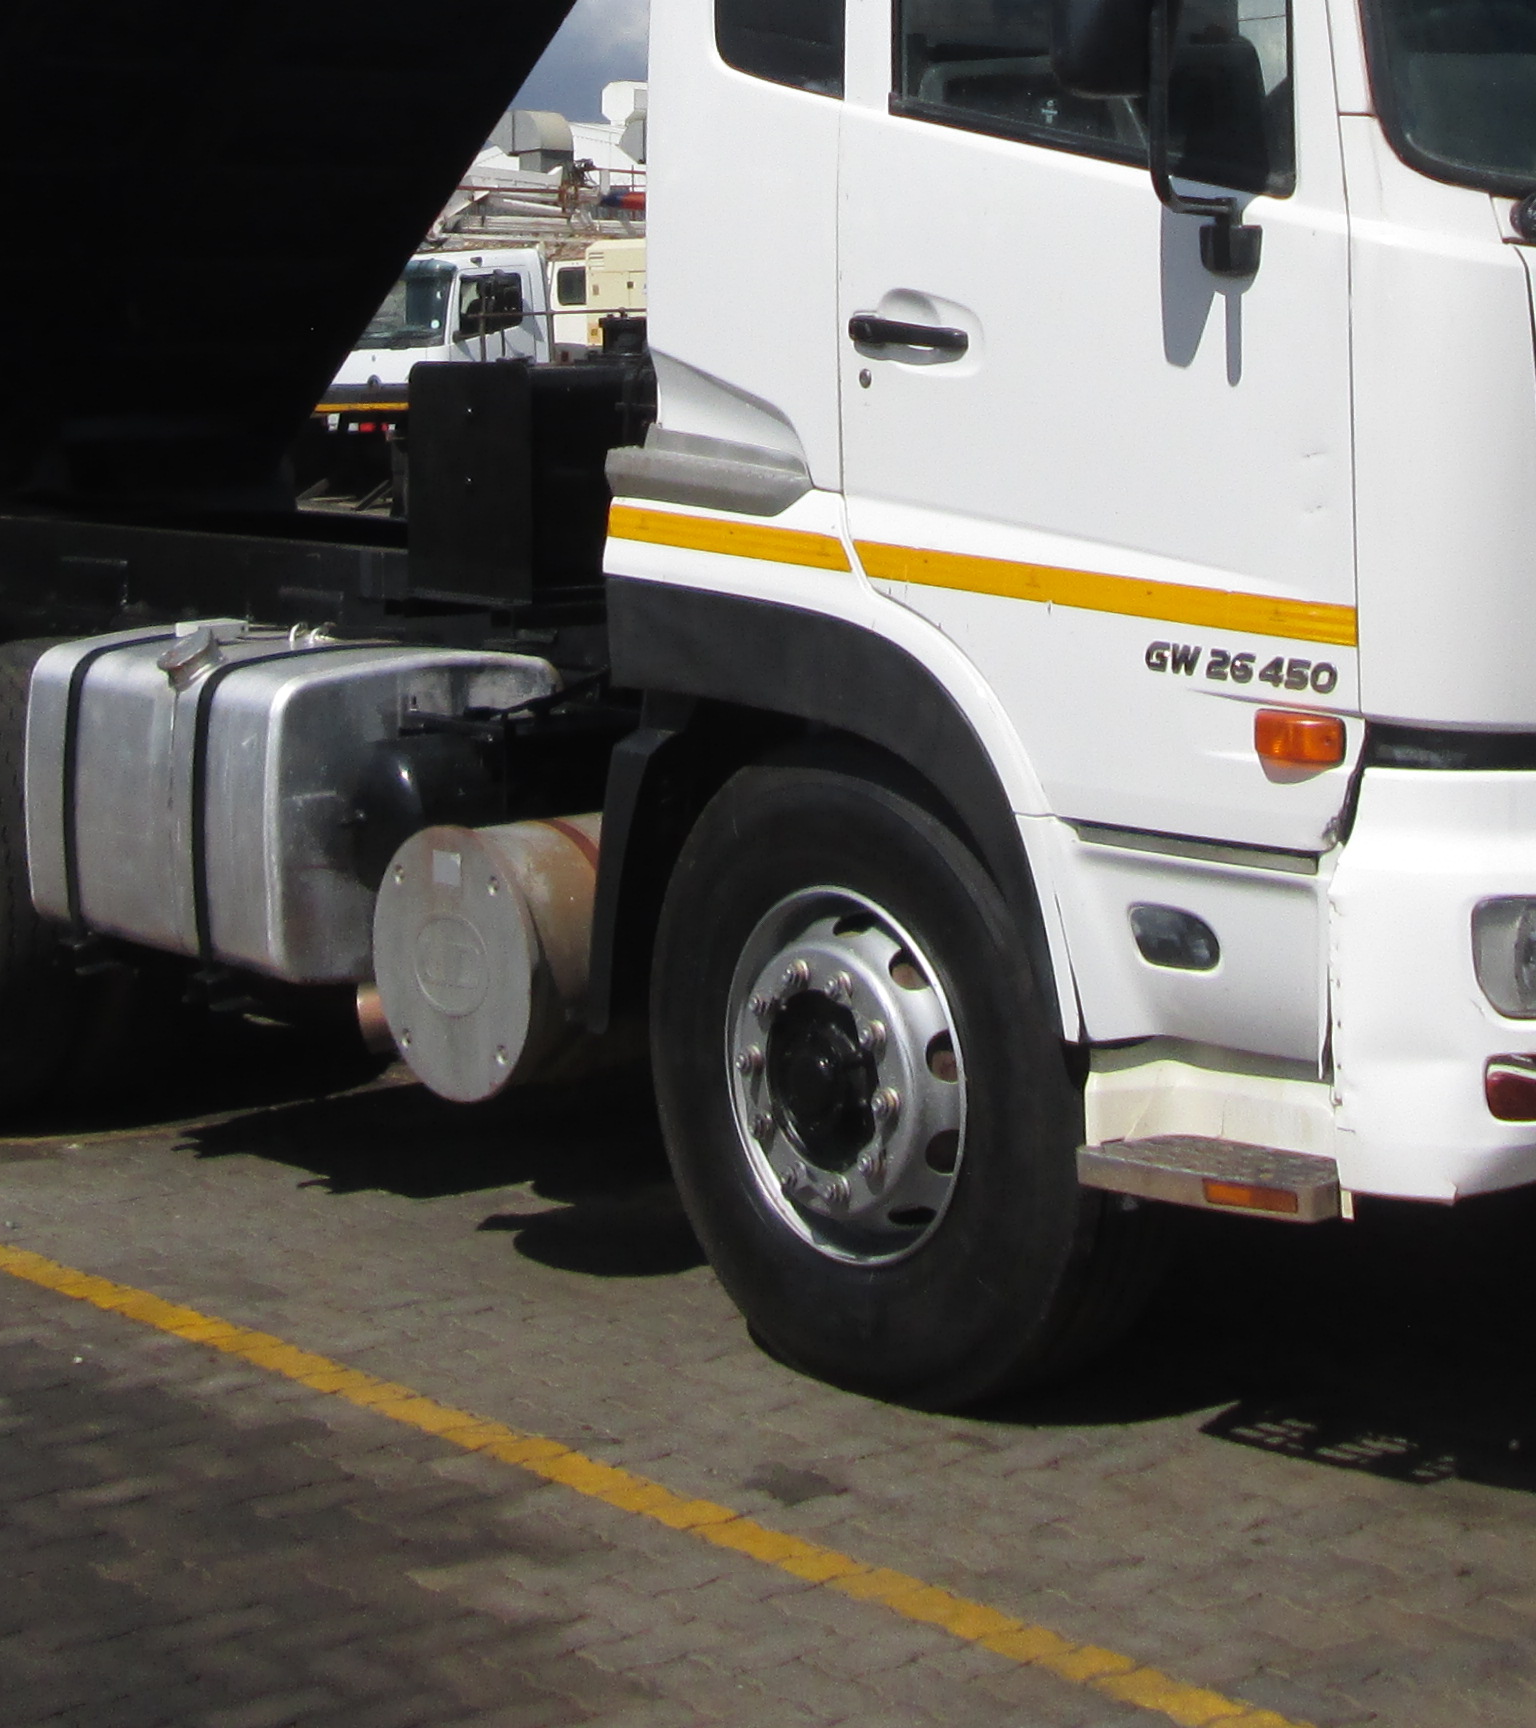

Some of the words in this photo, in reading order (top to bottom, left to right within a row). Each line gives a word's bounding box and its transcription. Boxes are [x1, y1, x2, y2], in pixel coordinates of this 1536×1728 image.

[1144, 640, 1202, 676] GW
[1206, 648, 1257, 683] 26
[1259, 656, 1338, 694] 450
